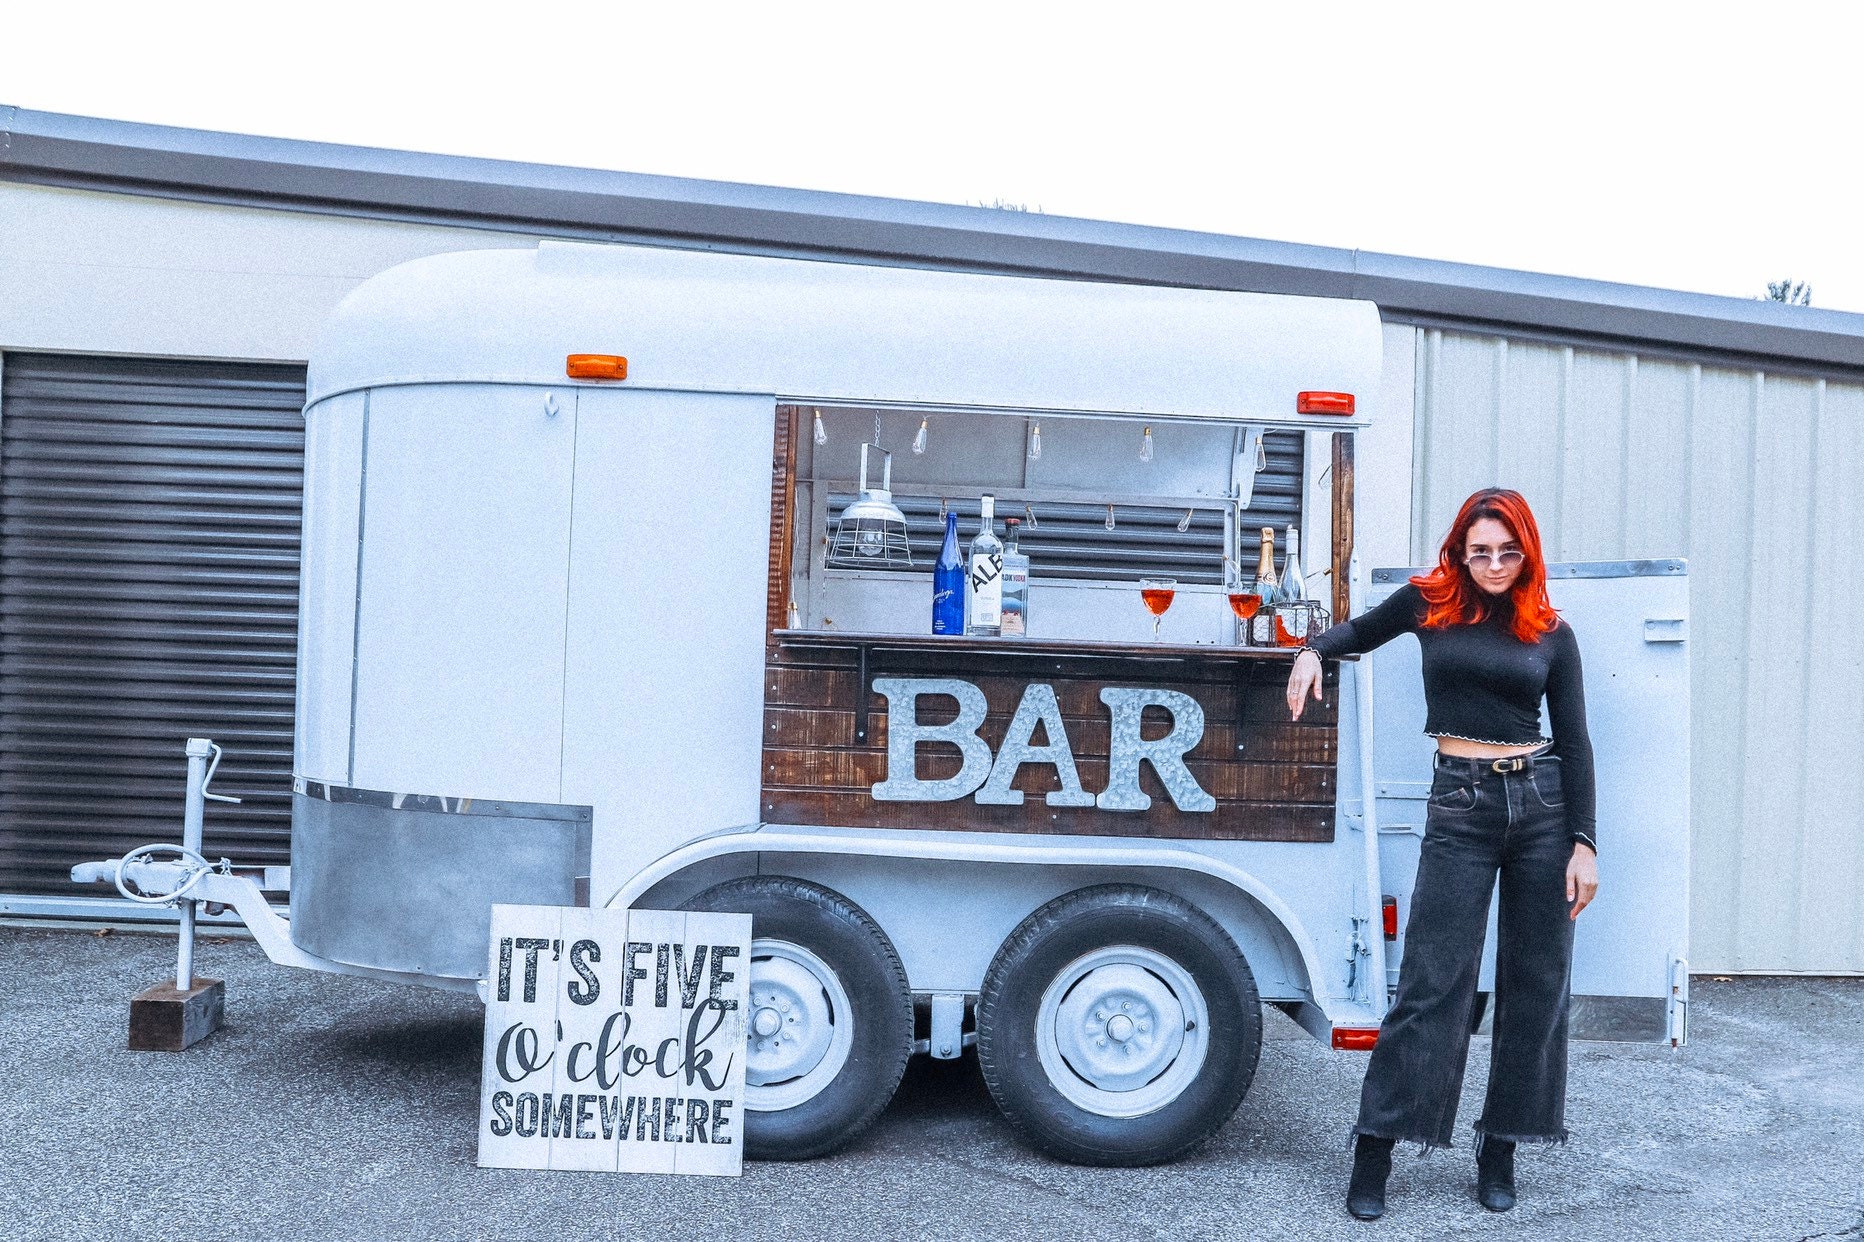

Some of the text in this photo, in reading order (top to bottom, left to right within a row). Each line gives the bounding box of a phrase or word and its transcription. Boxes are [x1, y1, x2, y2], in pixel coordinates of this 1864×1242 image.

[871, 677, 1216, 812] BAR
[497, 937, 741, 1011] IT'S FIVE
[490, 1090, 734, 1145] SOMEWHERE
